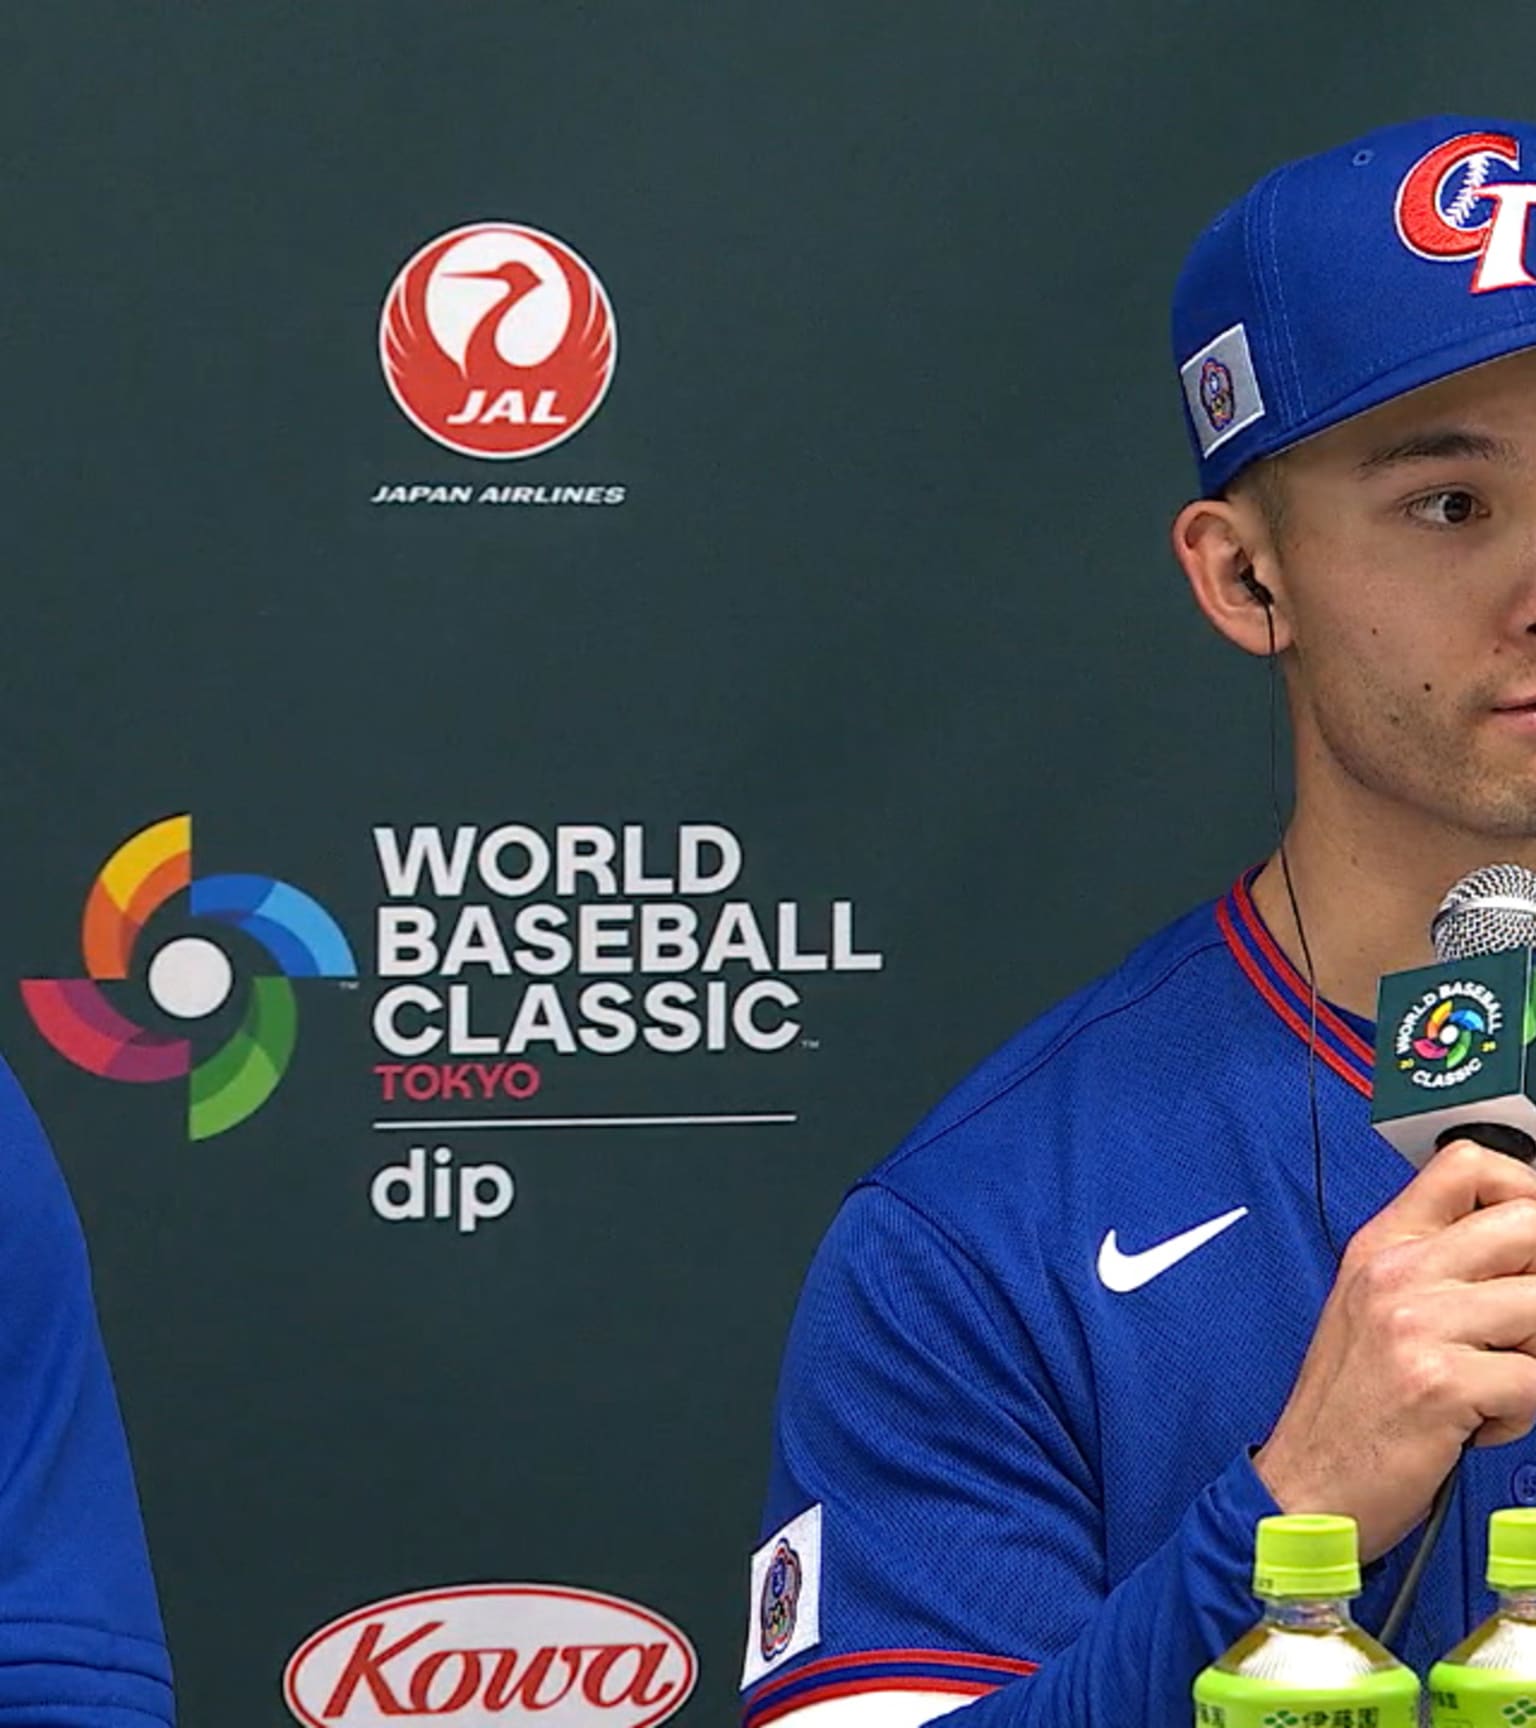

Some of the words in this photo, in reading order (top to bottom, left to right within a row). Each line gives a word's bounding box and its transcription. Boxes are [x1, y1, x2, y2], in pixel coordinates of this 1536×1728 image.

[446, 389, 568, 424] JAL
[371, 486, 473, 503] JAPAN
[478, 486, 626, 503] AIRLINES
[373, 825, 742, 897] WORLD
[376, 902, 883, 976] BASEBALL
[372, 980, 801, 1056] CLASSIC
[1395, 992, 1438, 1055] WORLD
[1437, 981, 1503, 1035] BASEBALL
[373, 1063, 541, 1100] TOKYO
[1411, 1057, 1483, 1088] CLASSIC
[370, 1147, 515, 1232] dip
[322, 1621, 676, 1718] Kowa
